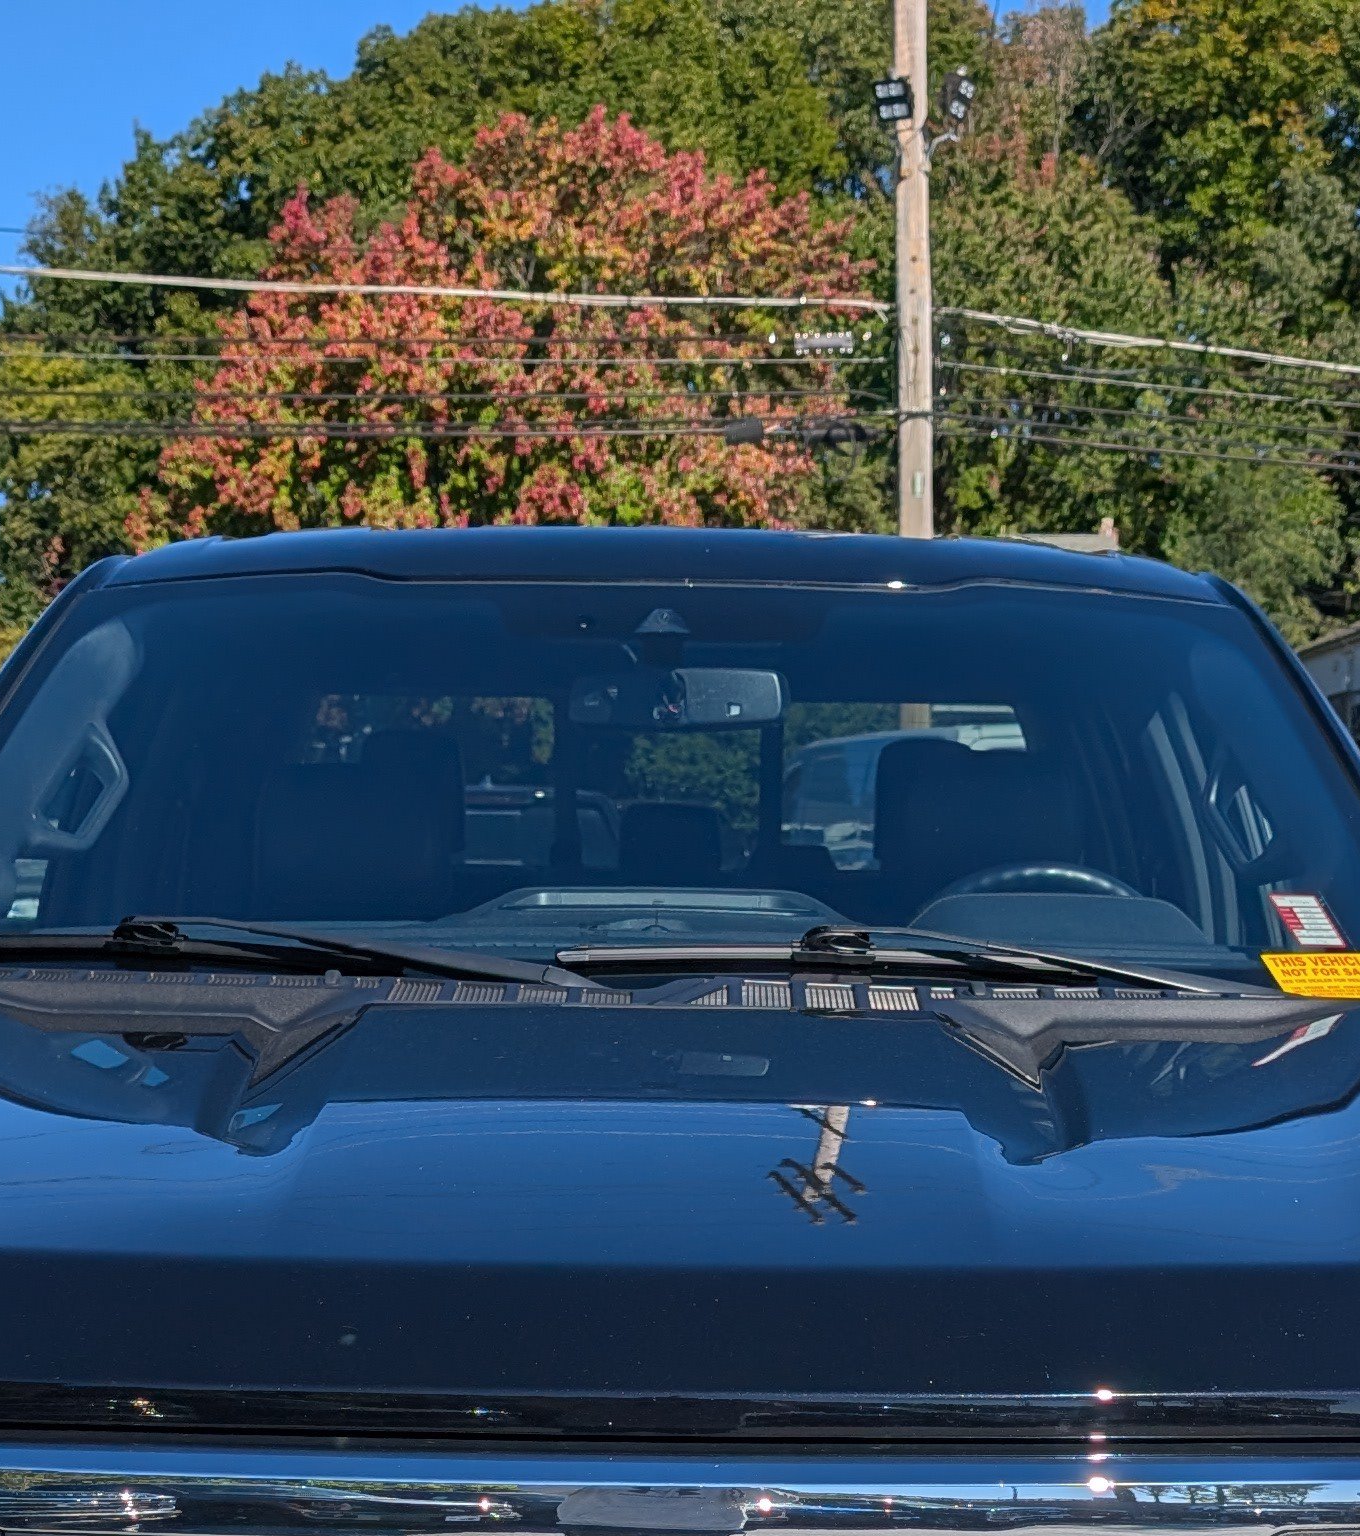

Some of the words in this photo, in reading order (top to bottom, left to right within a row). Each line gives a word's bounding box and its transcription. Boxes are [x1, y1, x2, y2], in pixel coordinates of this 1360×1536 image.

[1269, 956, 1306, 968] THIS
[1281, 968, 1307, 977] NOT
[1311, 968, 1340, 977] FOR
